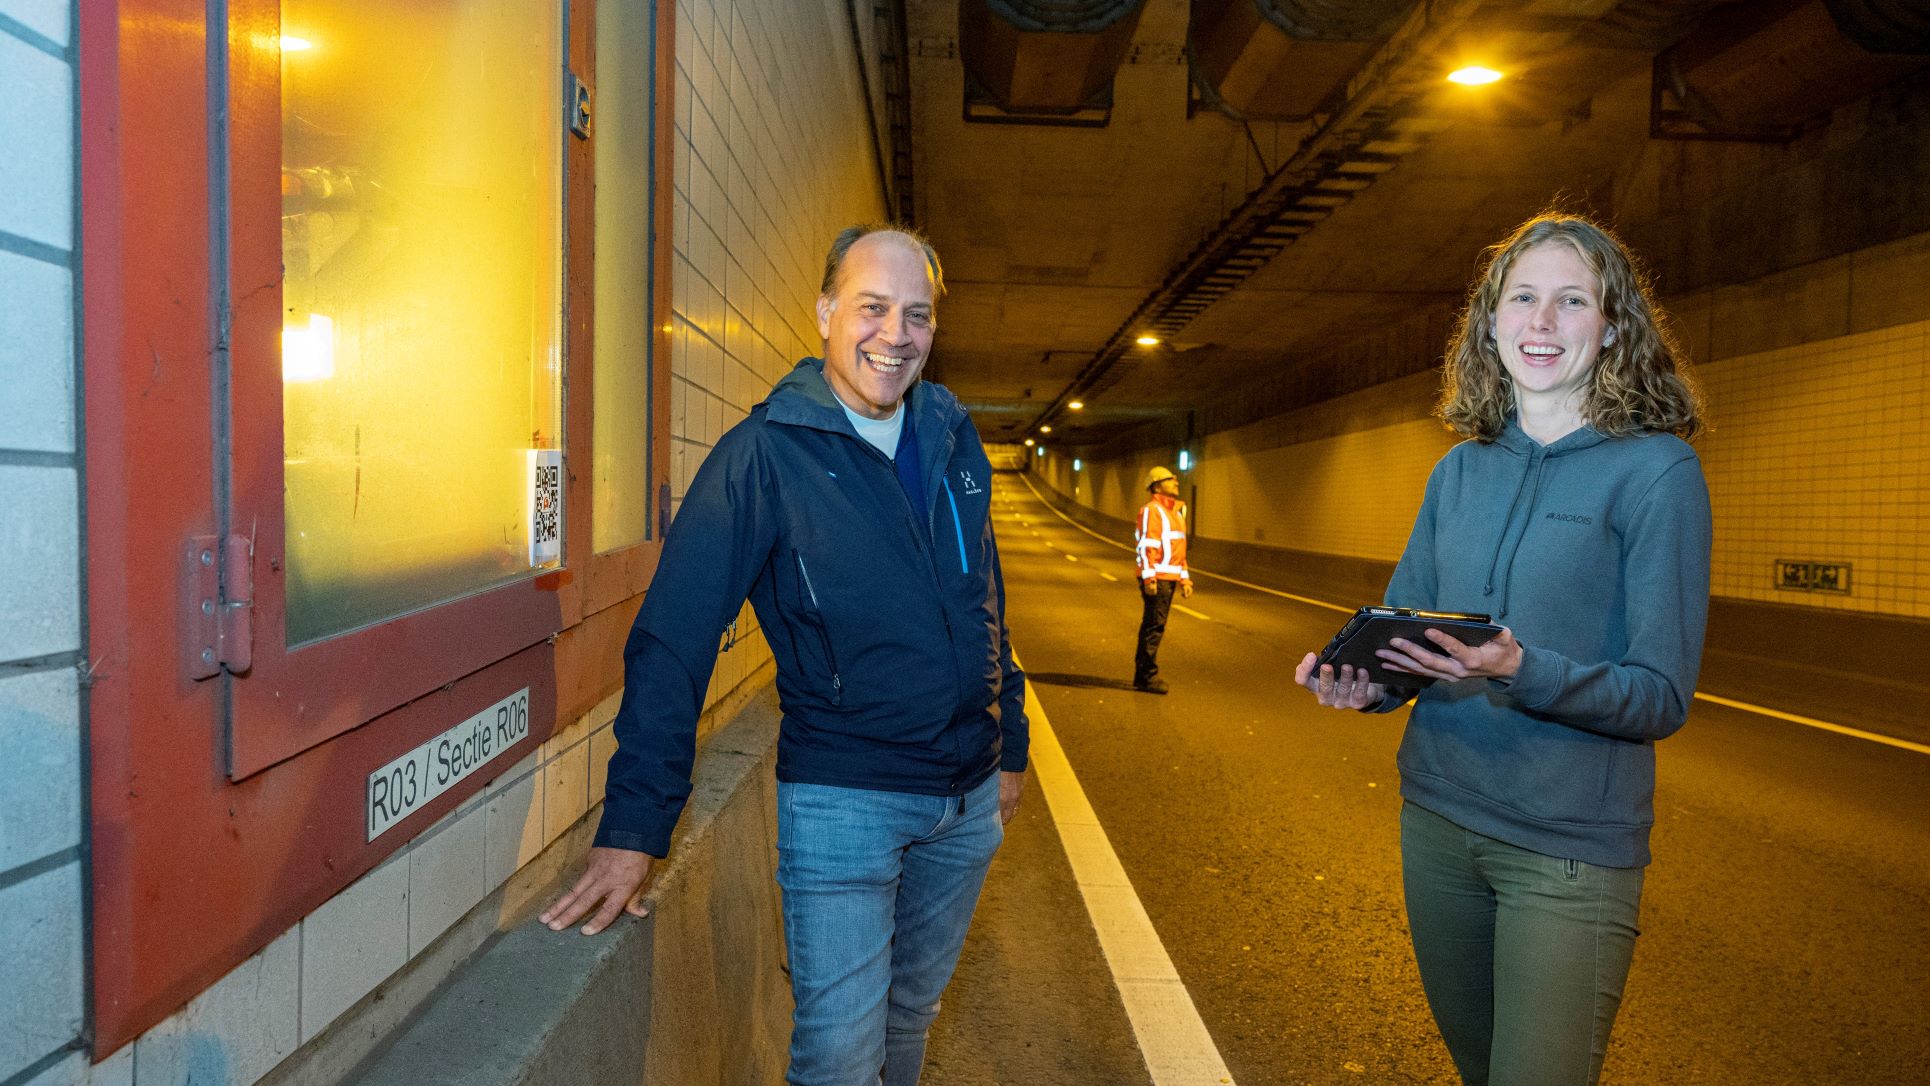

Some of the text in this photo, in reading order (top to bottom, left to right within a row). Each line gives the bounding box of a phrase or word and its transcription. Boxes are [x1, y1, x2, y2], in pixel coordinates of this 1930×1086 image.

[372, 695, 527, 831] R03 / Sectie R06
